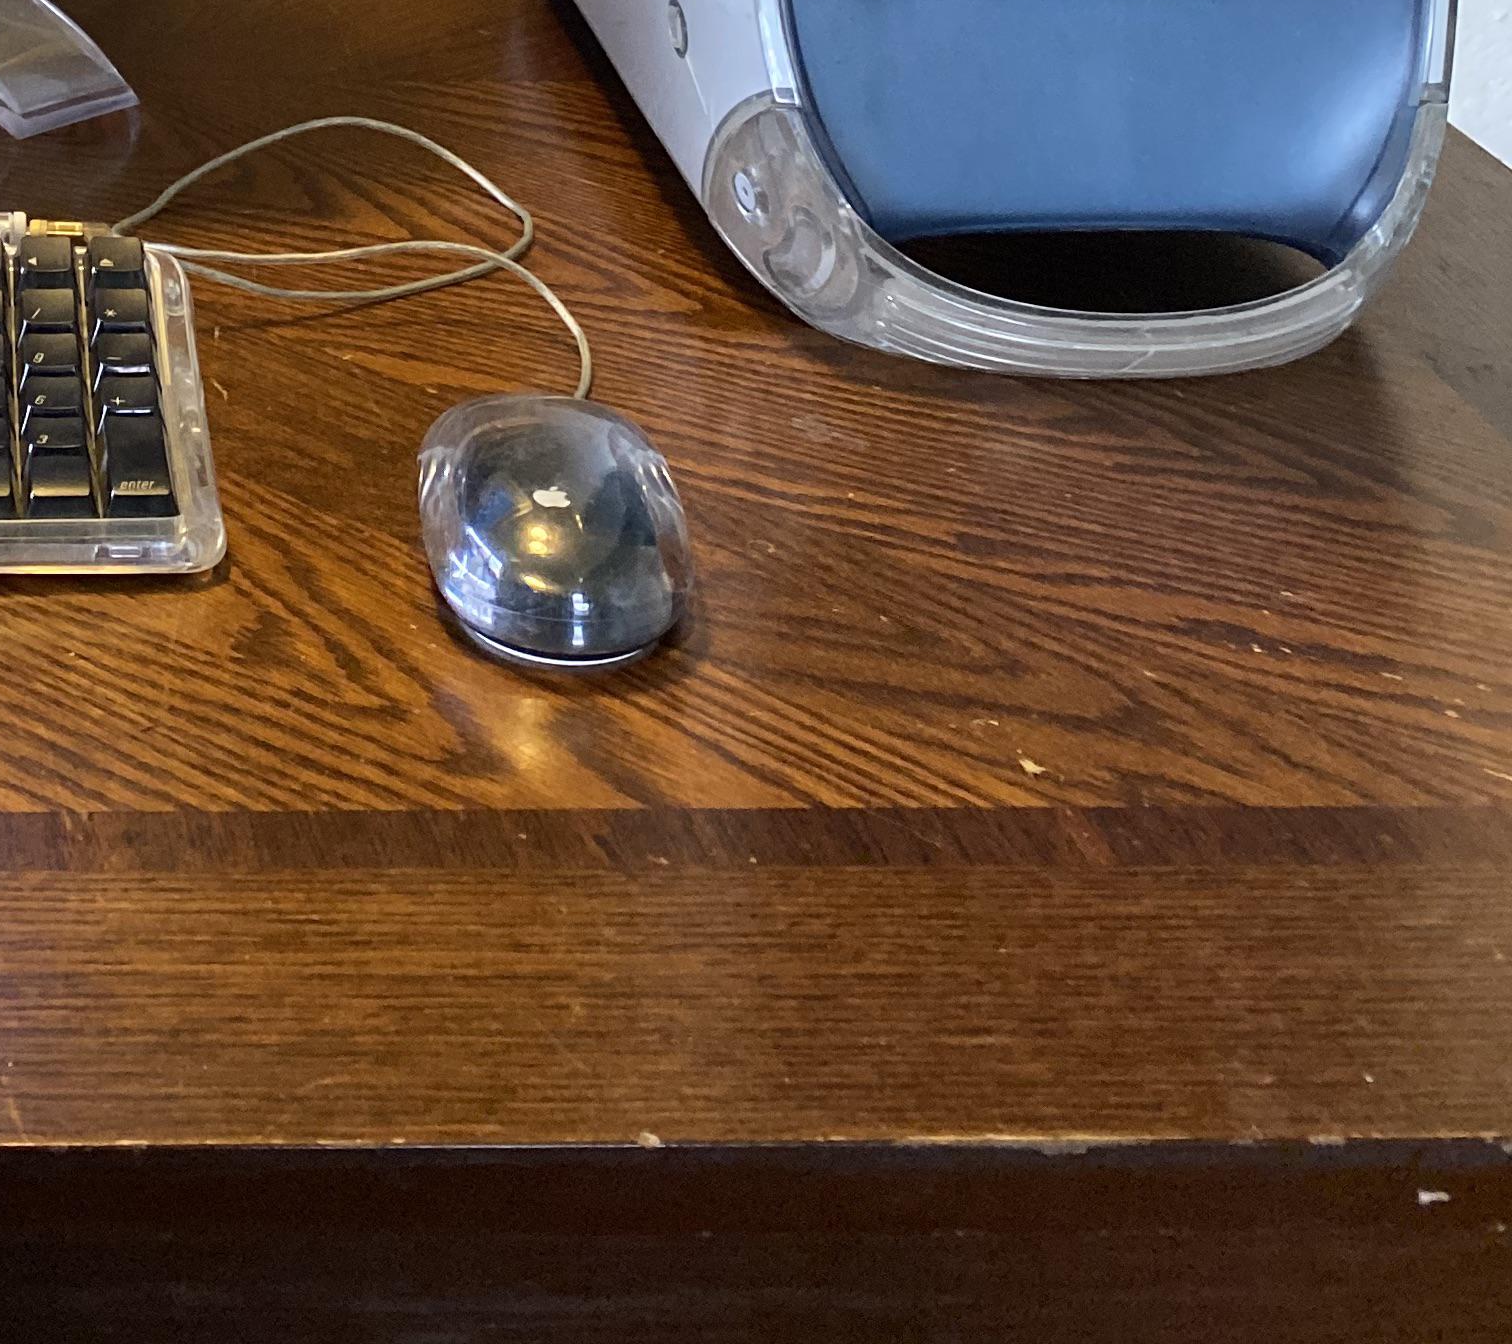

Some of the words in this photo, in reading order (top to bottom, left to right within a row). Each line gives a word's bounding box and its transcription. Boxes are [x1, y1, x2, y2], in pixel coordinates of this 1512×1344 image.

[32, 352, 45, 364] 9
[34, 394, 46, 405] 6
[37, 434, 49, 444] 3
[120, 478, 155, 490] enter
